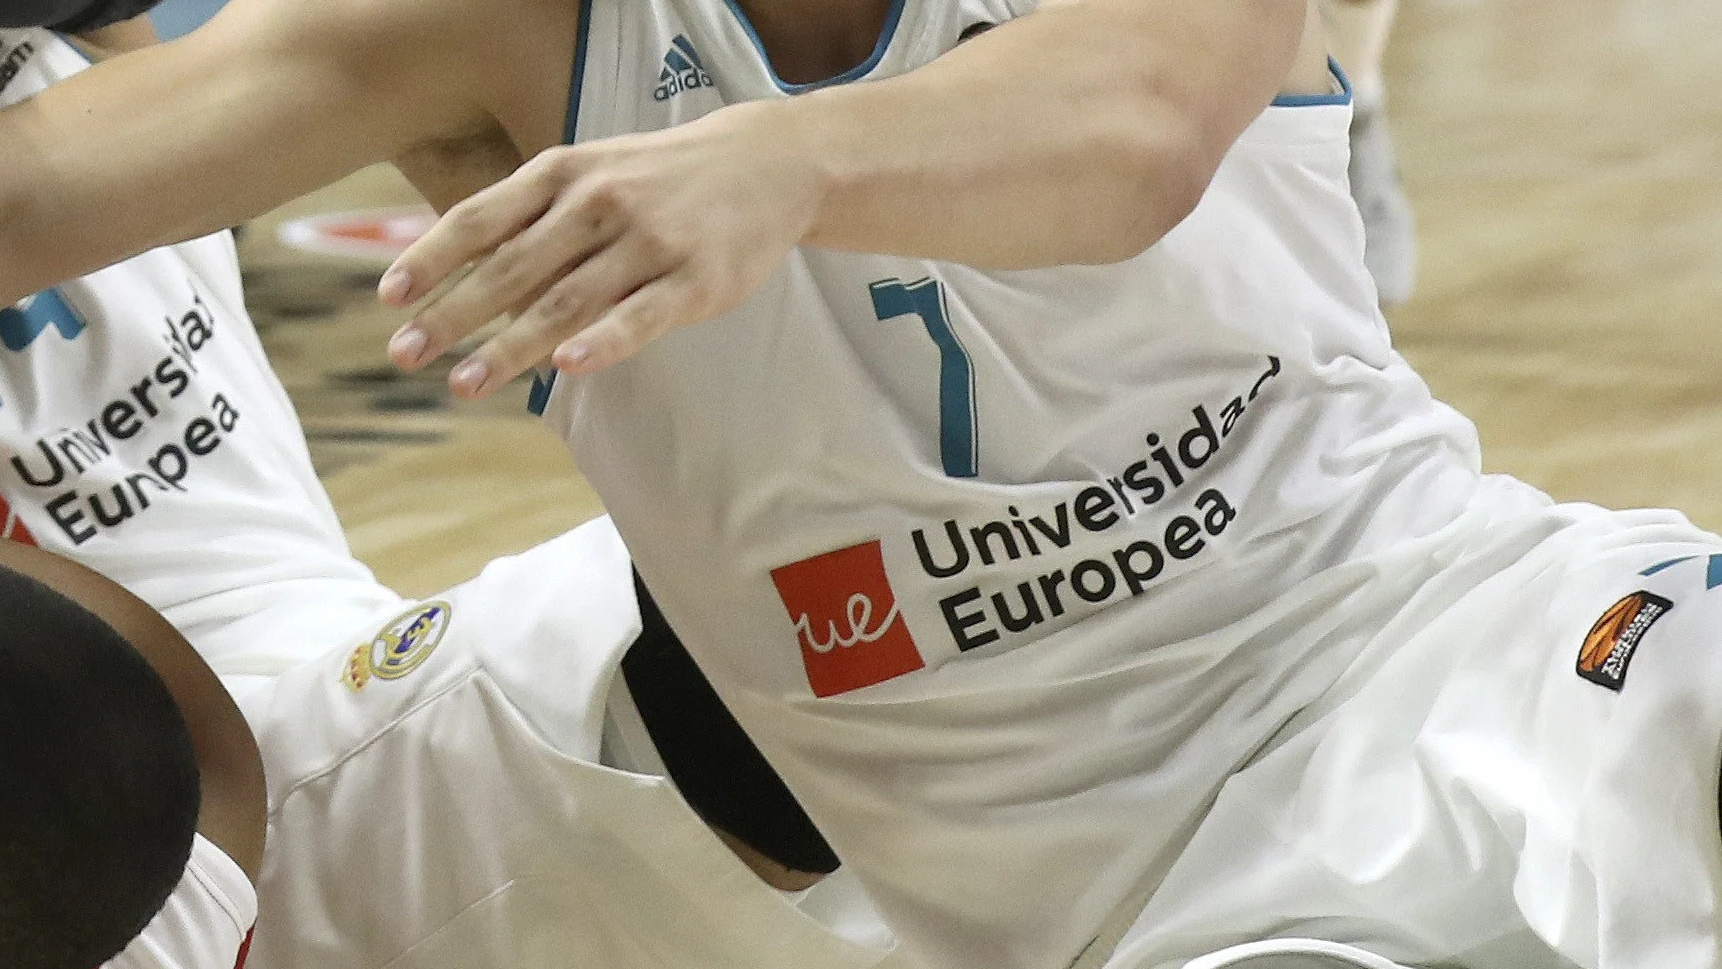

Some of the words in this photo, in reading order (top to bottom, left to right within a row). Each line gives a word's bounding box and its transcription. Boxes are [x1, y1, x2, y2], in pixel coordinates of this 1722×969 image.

[868, 277, 978, 478] 7
[795, 592, 900, 654] ue
[939, 487, 1237, 653] Europea
